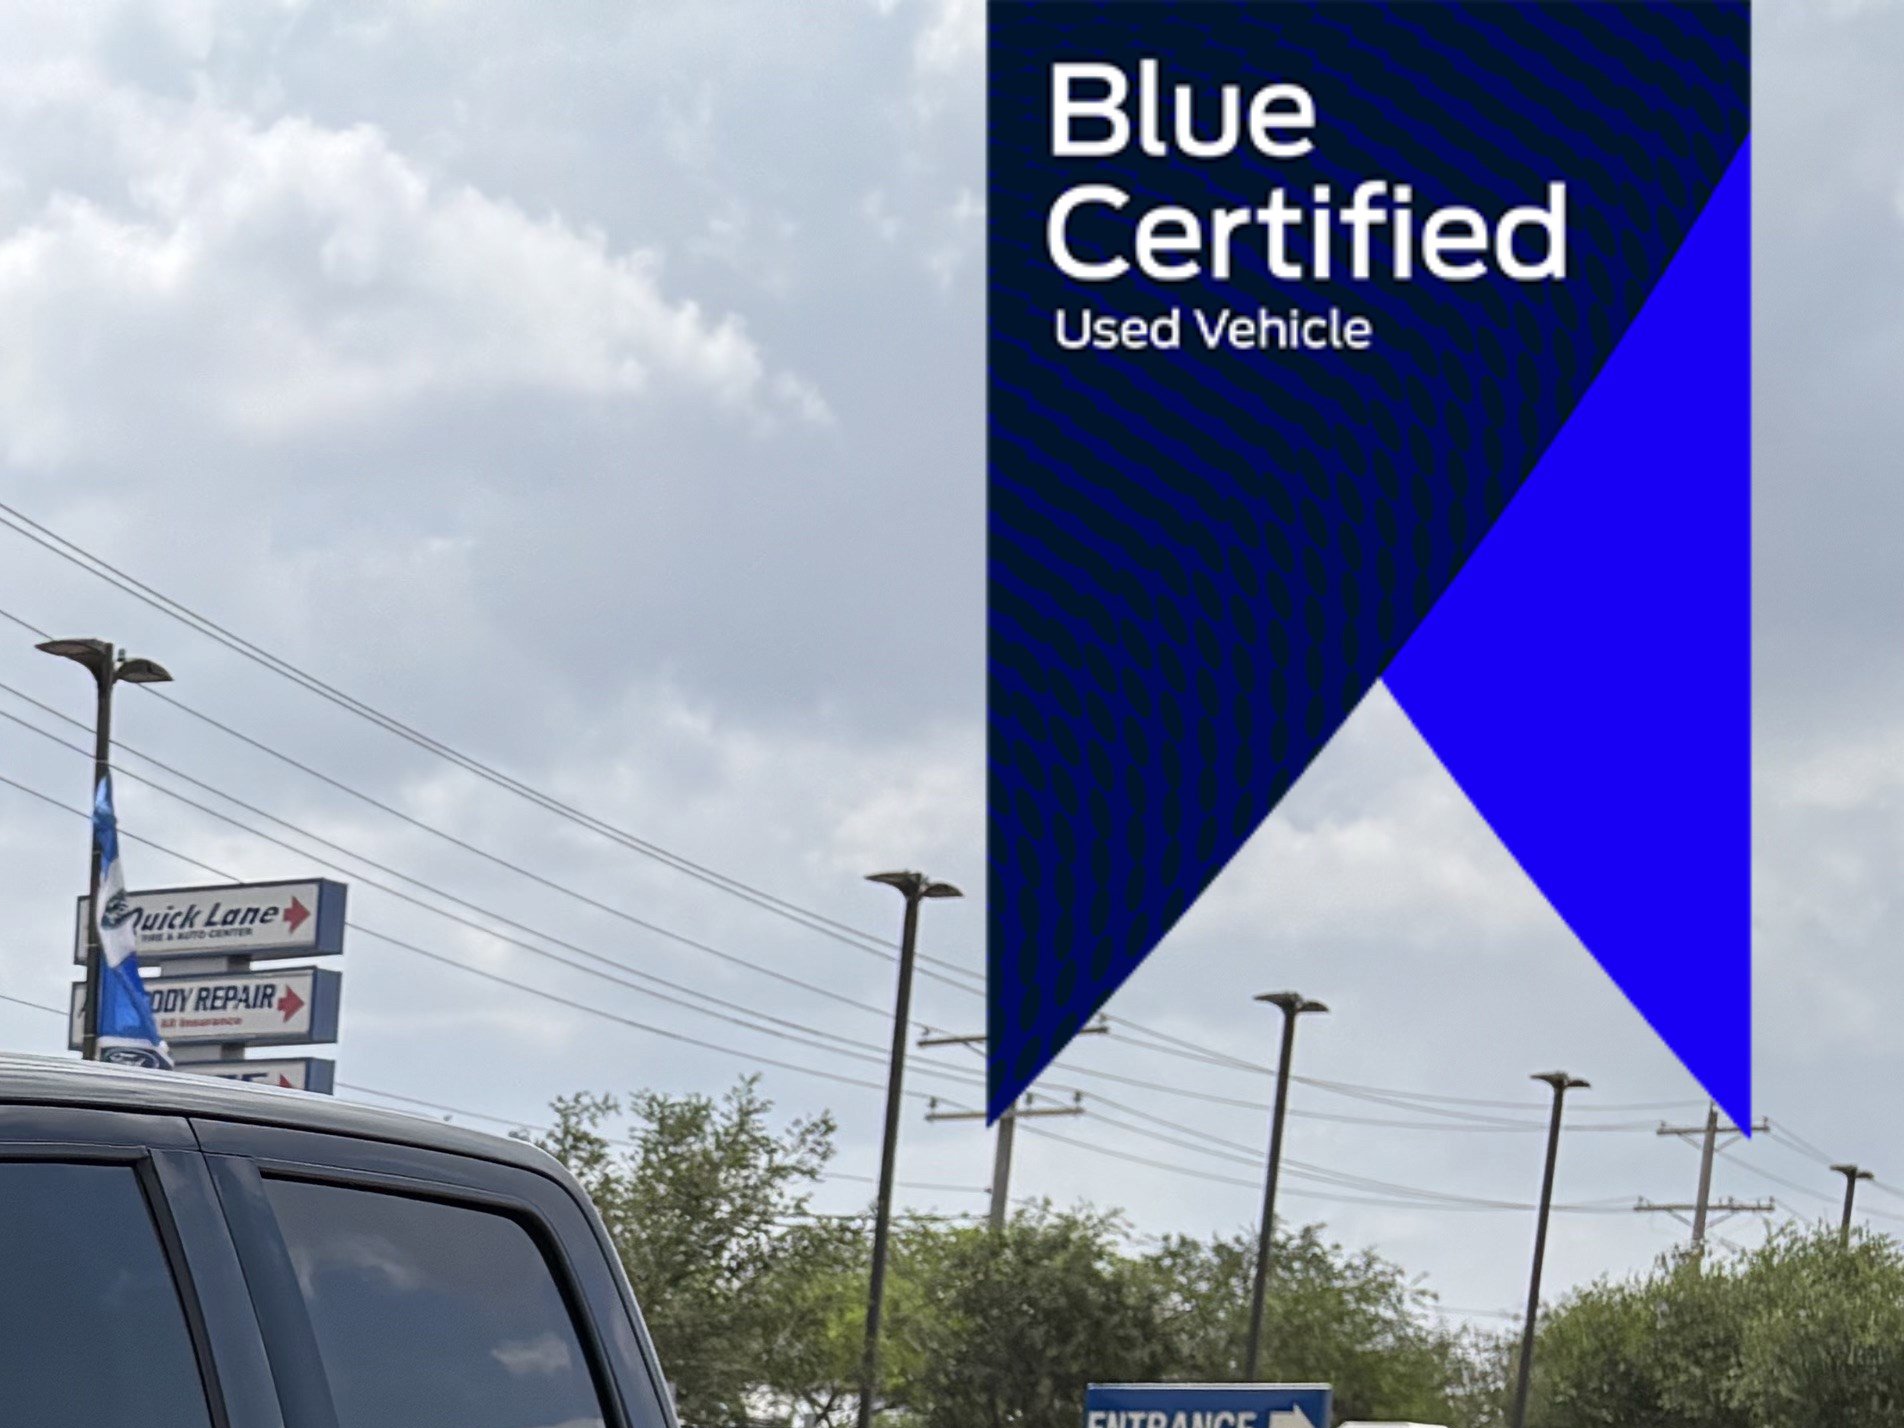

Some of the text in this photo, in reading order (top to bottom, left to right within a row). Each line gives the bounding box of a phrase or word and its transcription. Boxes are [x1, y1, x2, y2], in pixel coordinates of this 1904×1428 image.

[204, 902, 279, 927] Lane
[177, 929, 206, 940] AUTO
[195, 983, 276, 1012] REPAIR
